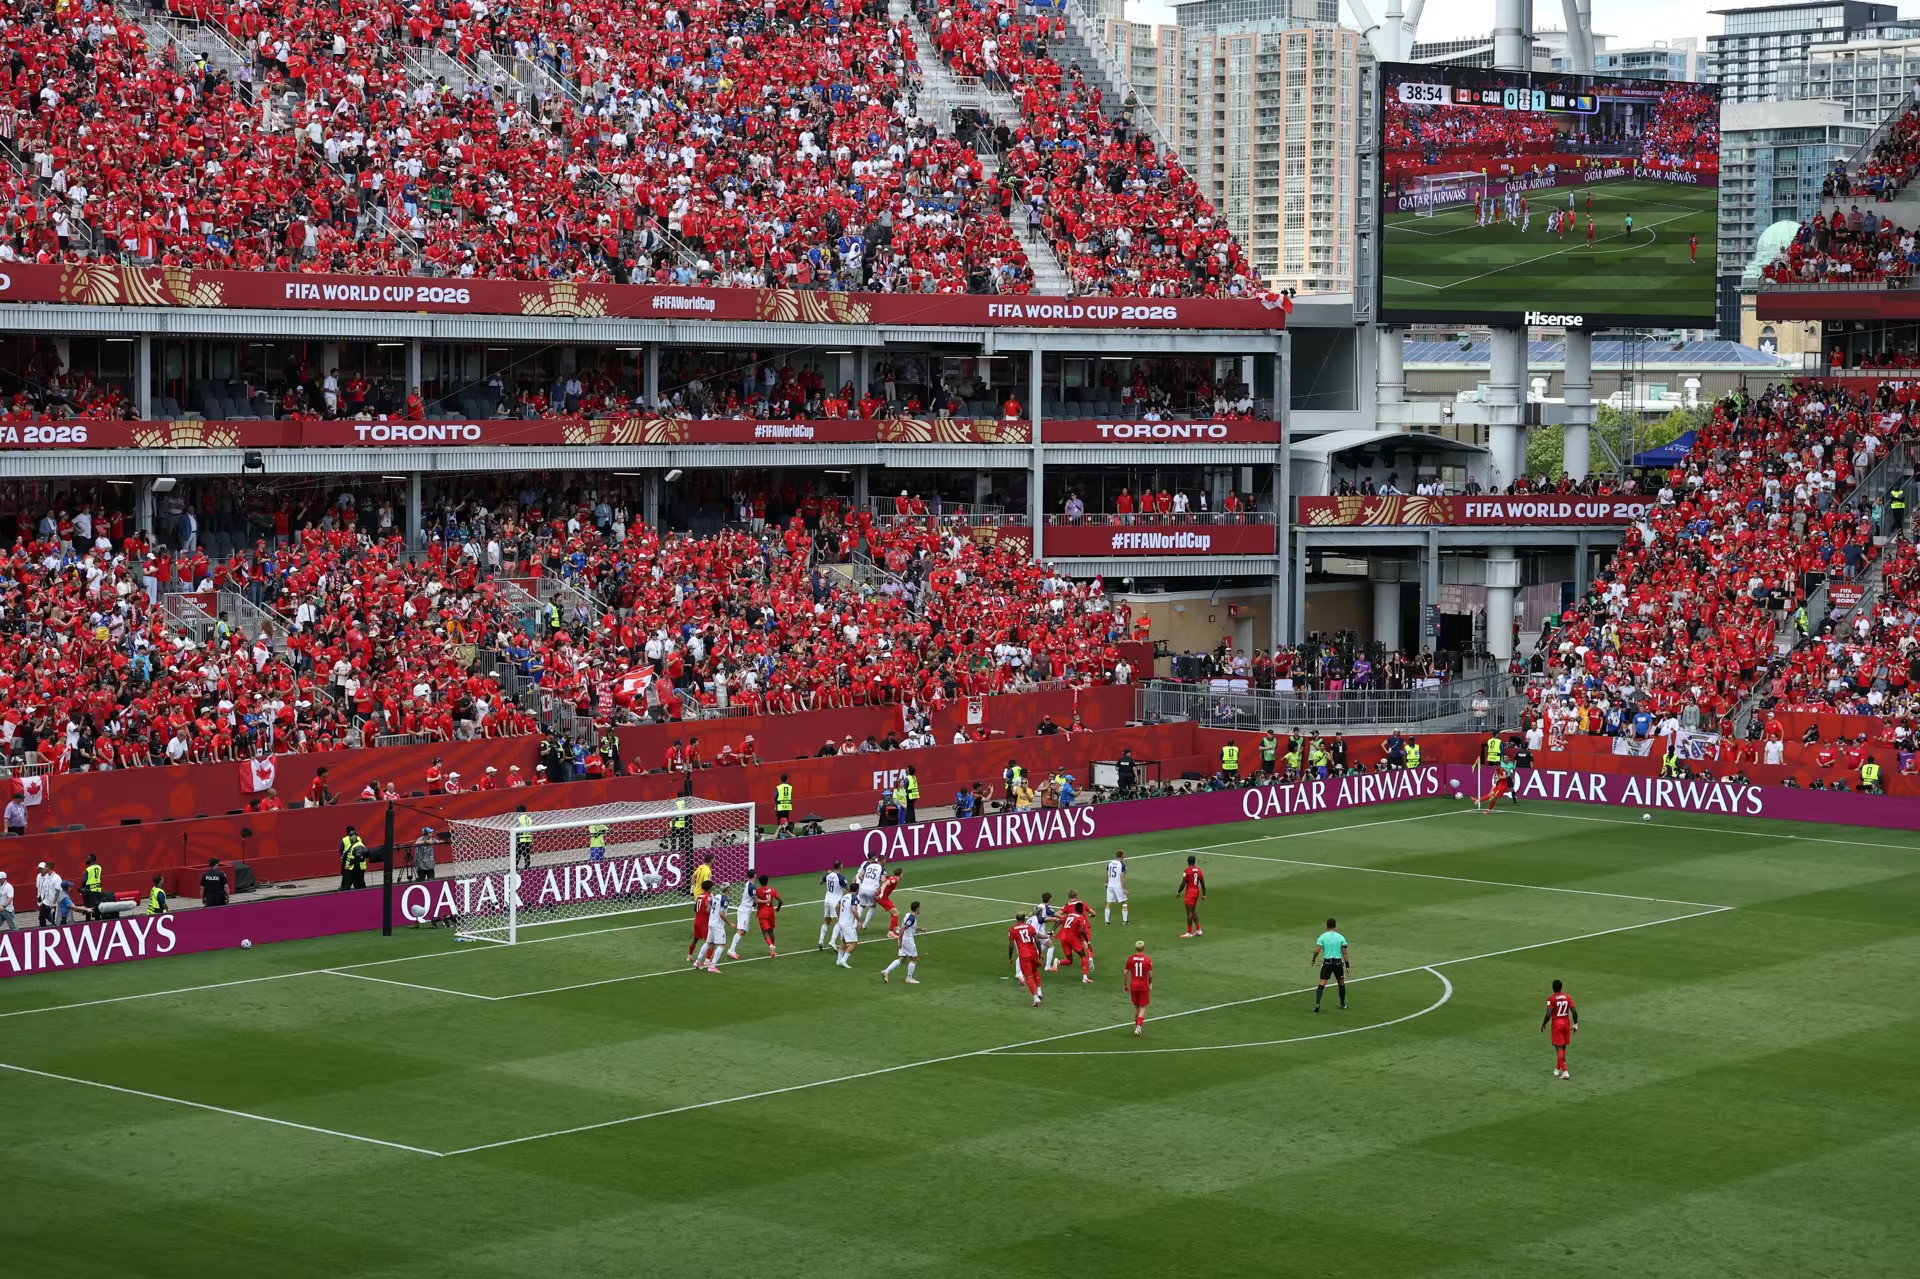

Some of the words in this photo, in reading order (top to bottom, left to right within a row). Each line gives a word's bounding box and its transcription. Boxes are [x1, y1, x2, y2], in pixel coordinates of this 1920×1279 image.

[1406, 85, 1443, 102] 38:54
[1482, 90, 1500, 104] CAN
[1507, 92, 1515, 105] 0
[1535, 94, 1542, 107] 1
[1550, 95, 1565, 108] BIH
[1584, 169, 1602, 182] QATAR
[1603, 167, 1625, 179] AIRWAYS
[1664, 171, 1697, 184] AIRWAYS
[1505, 180, 1527, 193] QATAR
[1530, 177, 1555, 190] AIRWAYS
[1399, 194, 1429, 210] QATAR
[1432, 188, 1467, 204] AIRWAYS
[285, 283, 321, 300] FIFA
[323, 284, 381, 301] WORLD
[383, 286, 415, 302] CUP
[416, 287, 471, 304] 2026
[652, 296, 716, 313] #FIFAWorldCup
[988, 303, 1023, 318] FIFA
[1025, 304, 1085, 319] WORLD
[1087, 305, 1119, 320] CUP
[1121, 306, 1177, 320] 2026
[1524, 311, 1584, 326] Hisense
[23, 425, 88, 443] 2026
[354, 424, 482, 441] TORONTO
[754, 424, 815, 440] #FIFAWorldCup
[1096, 424, 1228, 438] TORONTO
[1465, 502, 1503, 518] FIFA
[1506, 502, 1572, 518] WORLD
[1574, 502, 1611, 518] CUP
[1111, 531, 1211, 551] #FIFAWorldCup
[1242, 780, 1327, 820] QATAR
[1336, 766, 1439, 807] AIRWAYS
[1620, 776, 1763, 815] AIRWAYS
[863, 820, 963, 859] QATAR
[975, 806, 1096, 849] AIRWAYS
[865, 867, 878, 880] 25
[1109, 866, 1118, 878] 15
[401, 872, 523, 924] QATAR
[538, 853, 682, 904] AIRWAYS
[827, 880, 835, 893] 18
[1064, 916, 1075, 929] 12
[0, 914, 177, 972] AIRWAYS
[1019, 928, 1031, 943] 13
[1134, 962, 1143, 977] 11
[1556, 1000, 1569, 1017] 22
